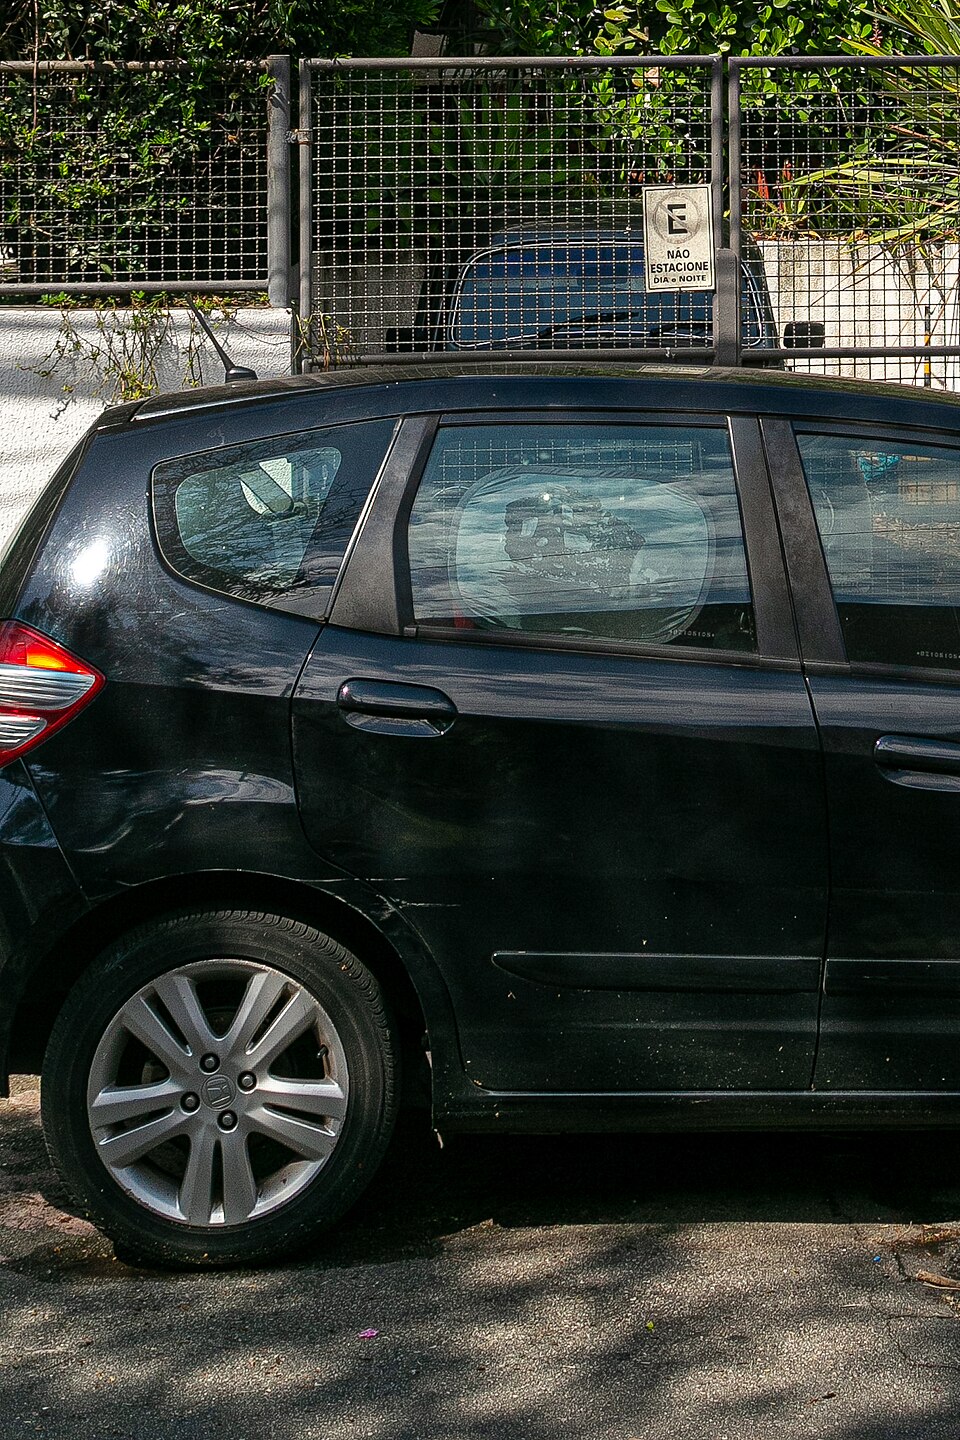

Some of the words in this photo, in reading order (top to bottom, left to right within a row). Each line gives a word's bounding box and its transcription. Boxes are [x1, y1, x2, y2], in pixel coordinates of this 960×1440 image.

[667, 203, 688, 235] E
[667, 247, 690, 259] NÃO
[650, 261, 709, 274] ESTACIONE
[679, 274, 706, 283] NOITE
